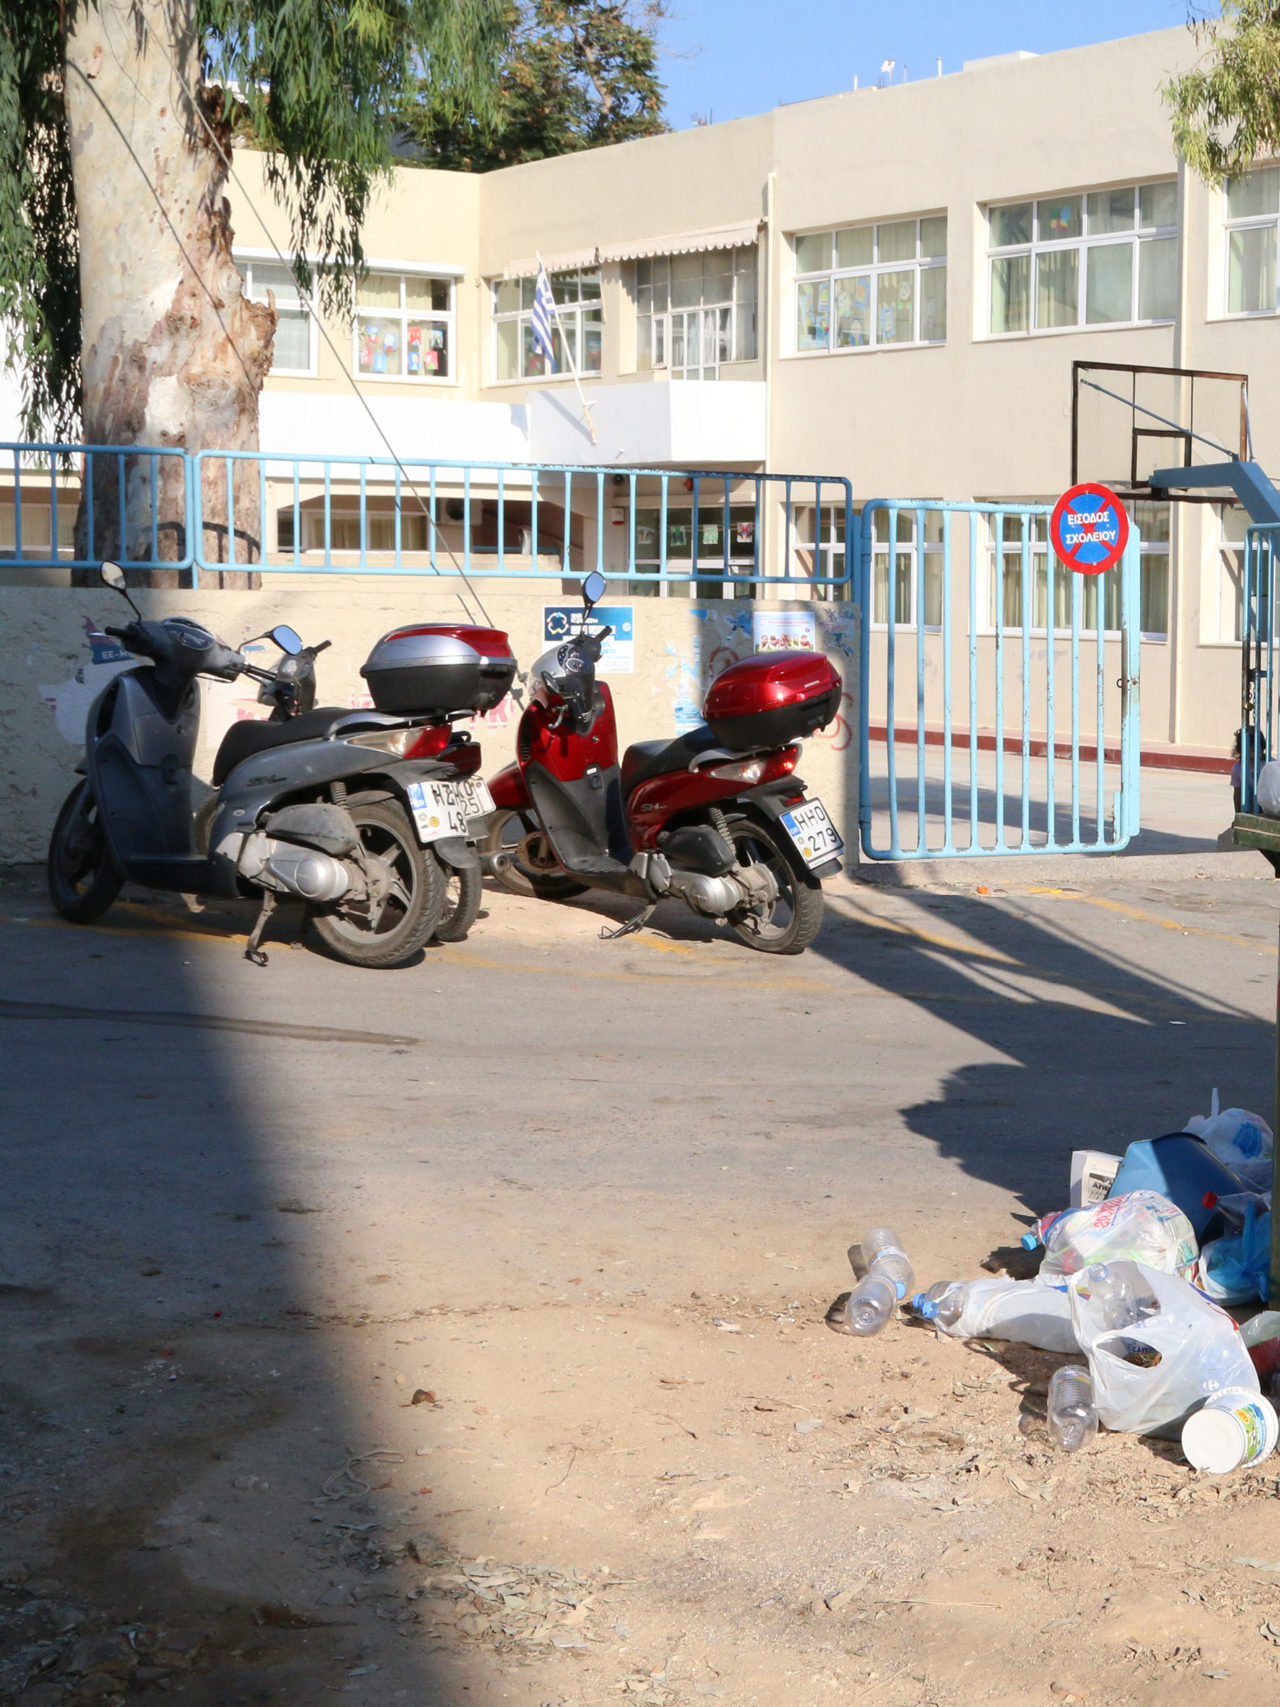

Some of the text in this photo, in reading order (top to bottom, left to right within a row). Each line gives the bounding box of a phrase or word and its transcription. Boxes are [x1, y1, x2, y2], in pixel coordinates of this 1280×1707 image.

[1067, 511, 1110, 525] ΕΙΣΟΔΟΣ
[1065, 530, 1117, 544] ΣΧΟΛΕΙΟΥ
[794, 805, 826, 831] HHO
[808, 827, 837, 852] 279
